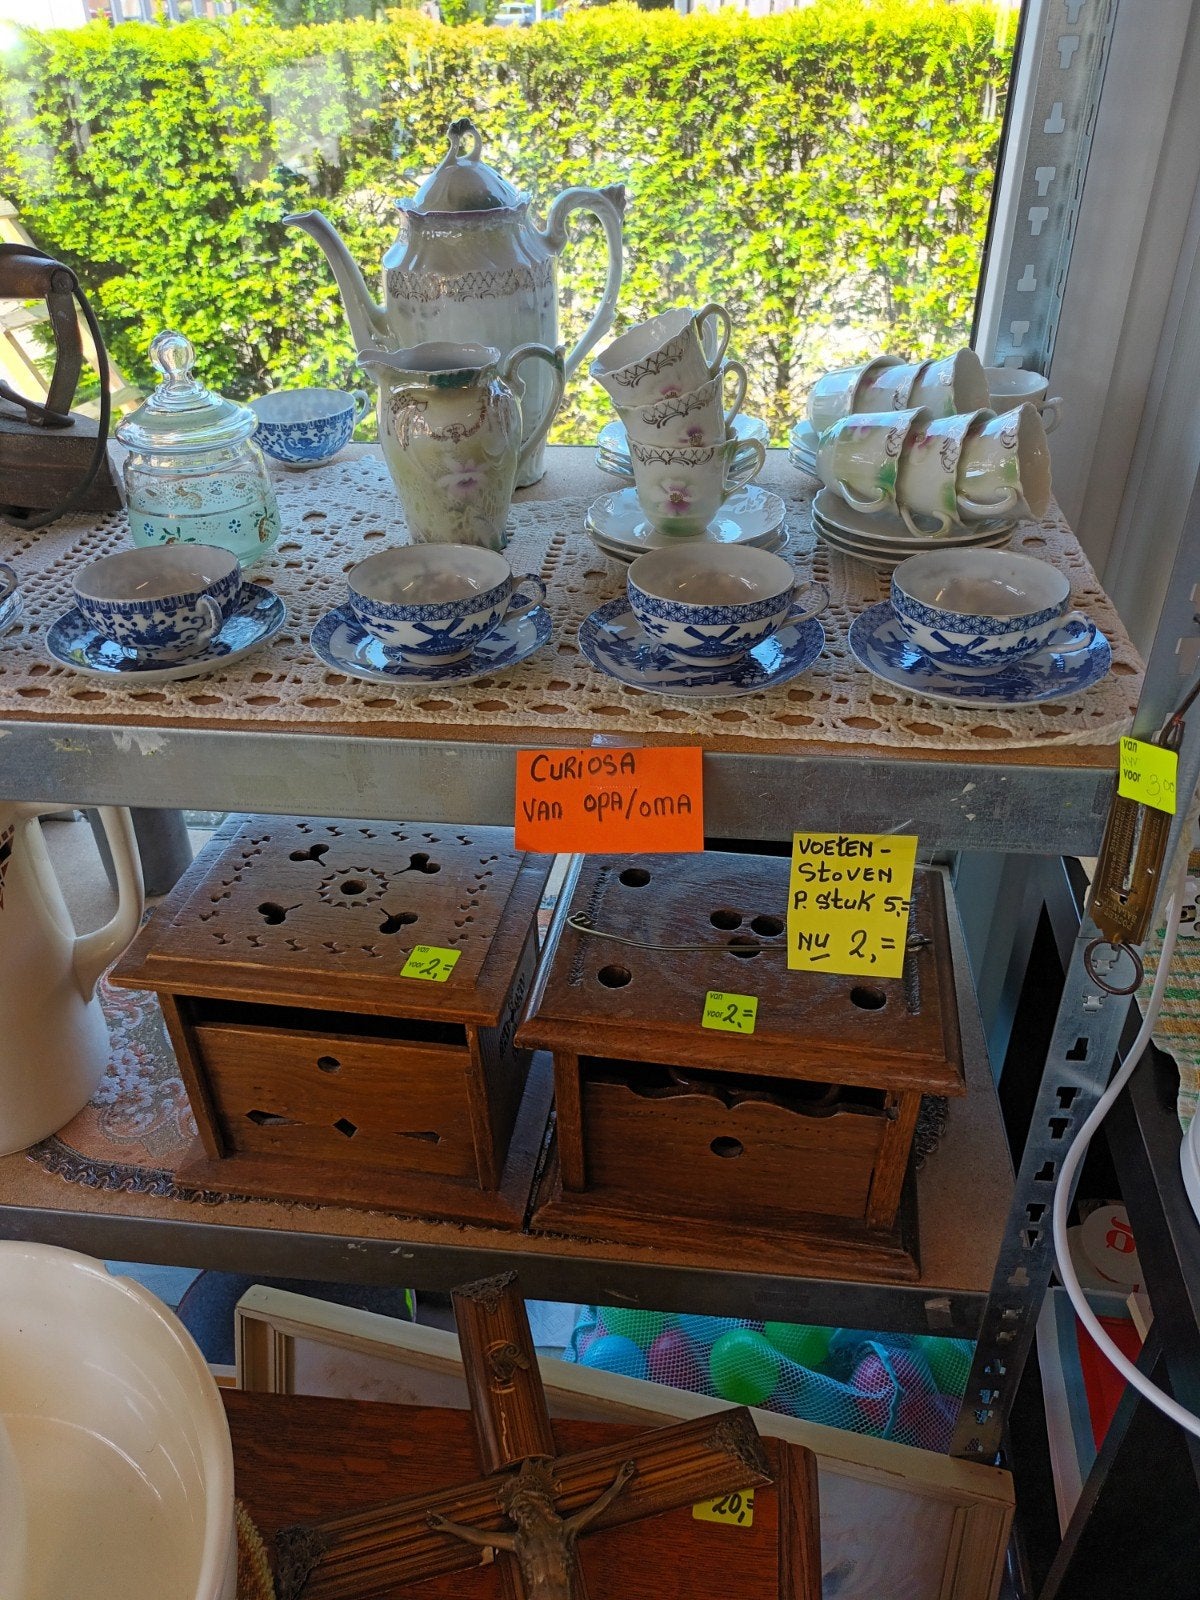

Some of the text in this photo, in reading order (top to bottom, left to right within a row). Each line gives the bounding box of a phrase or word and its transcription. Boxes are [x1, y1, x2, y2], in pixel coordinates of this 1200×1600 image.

[1123, 739, 1138, 753] van
[1123, 768, 1142, 782] voor
[798, 931, 830, 951] NU
[710, 992, 723, 1000] van
[707, 1010, 724, 1019] voor
